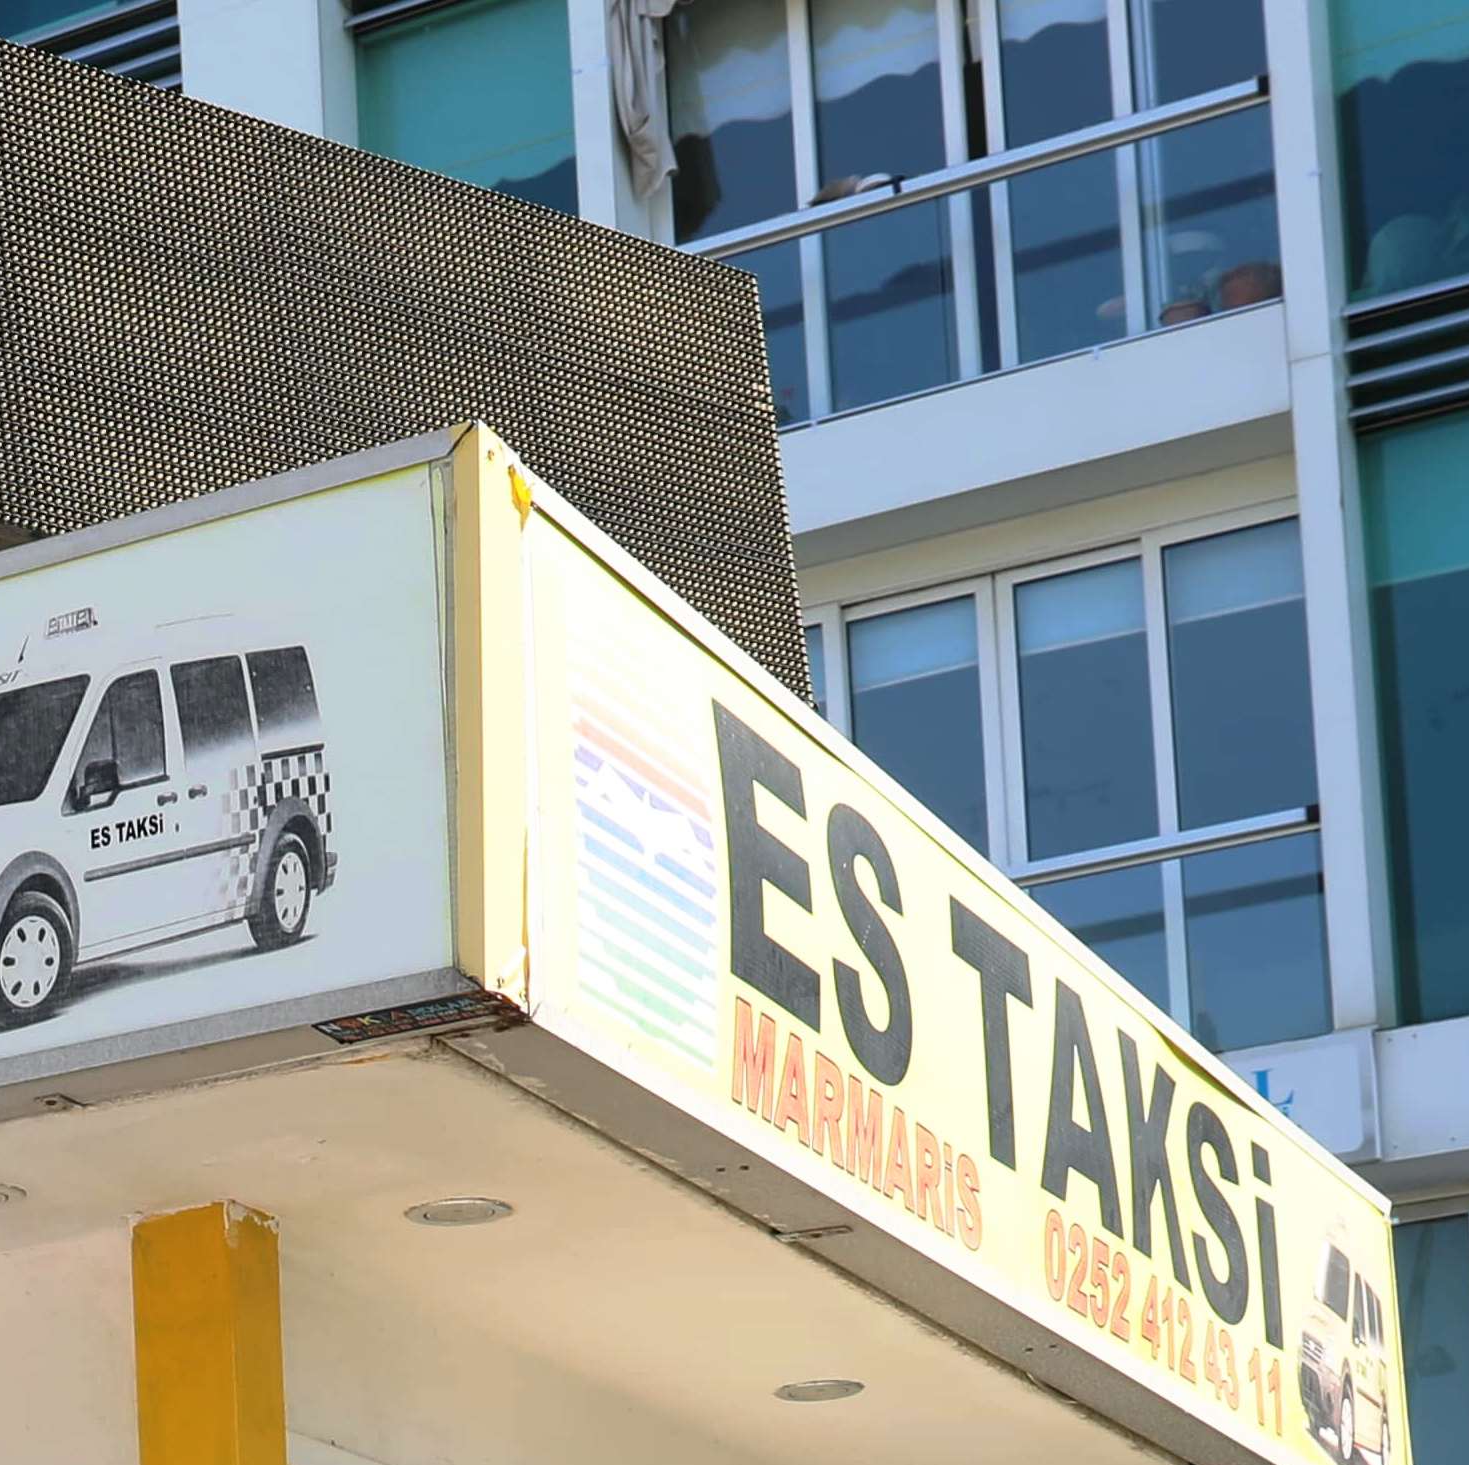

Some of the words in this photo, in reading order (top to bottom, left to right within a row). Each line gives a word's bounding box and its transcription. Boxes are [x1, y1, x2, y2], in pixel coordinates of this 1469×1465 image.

[90, 825, 111, 849] ES
[712, 698, 914, 1087] ES
[1044, 1207, 1131, 1343] 0252
[1141, 1271, 1196, 1384] 412
[1203, 1322, 1242, 1411] 43
[1247, 1351, 1285, 1437] 11
